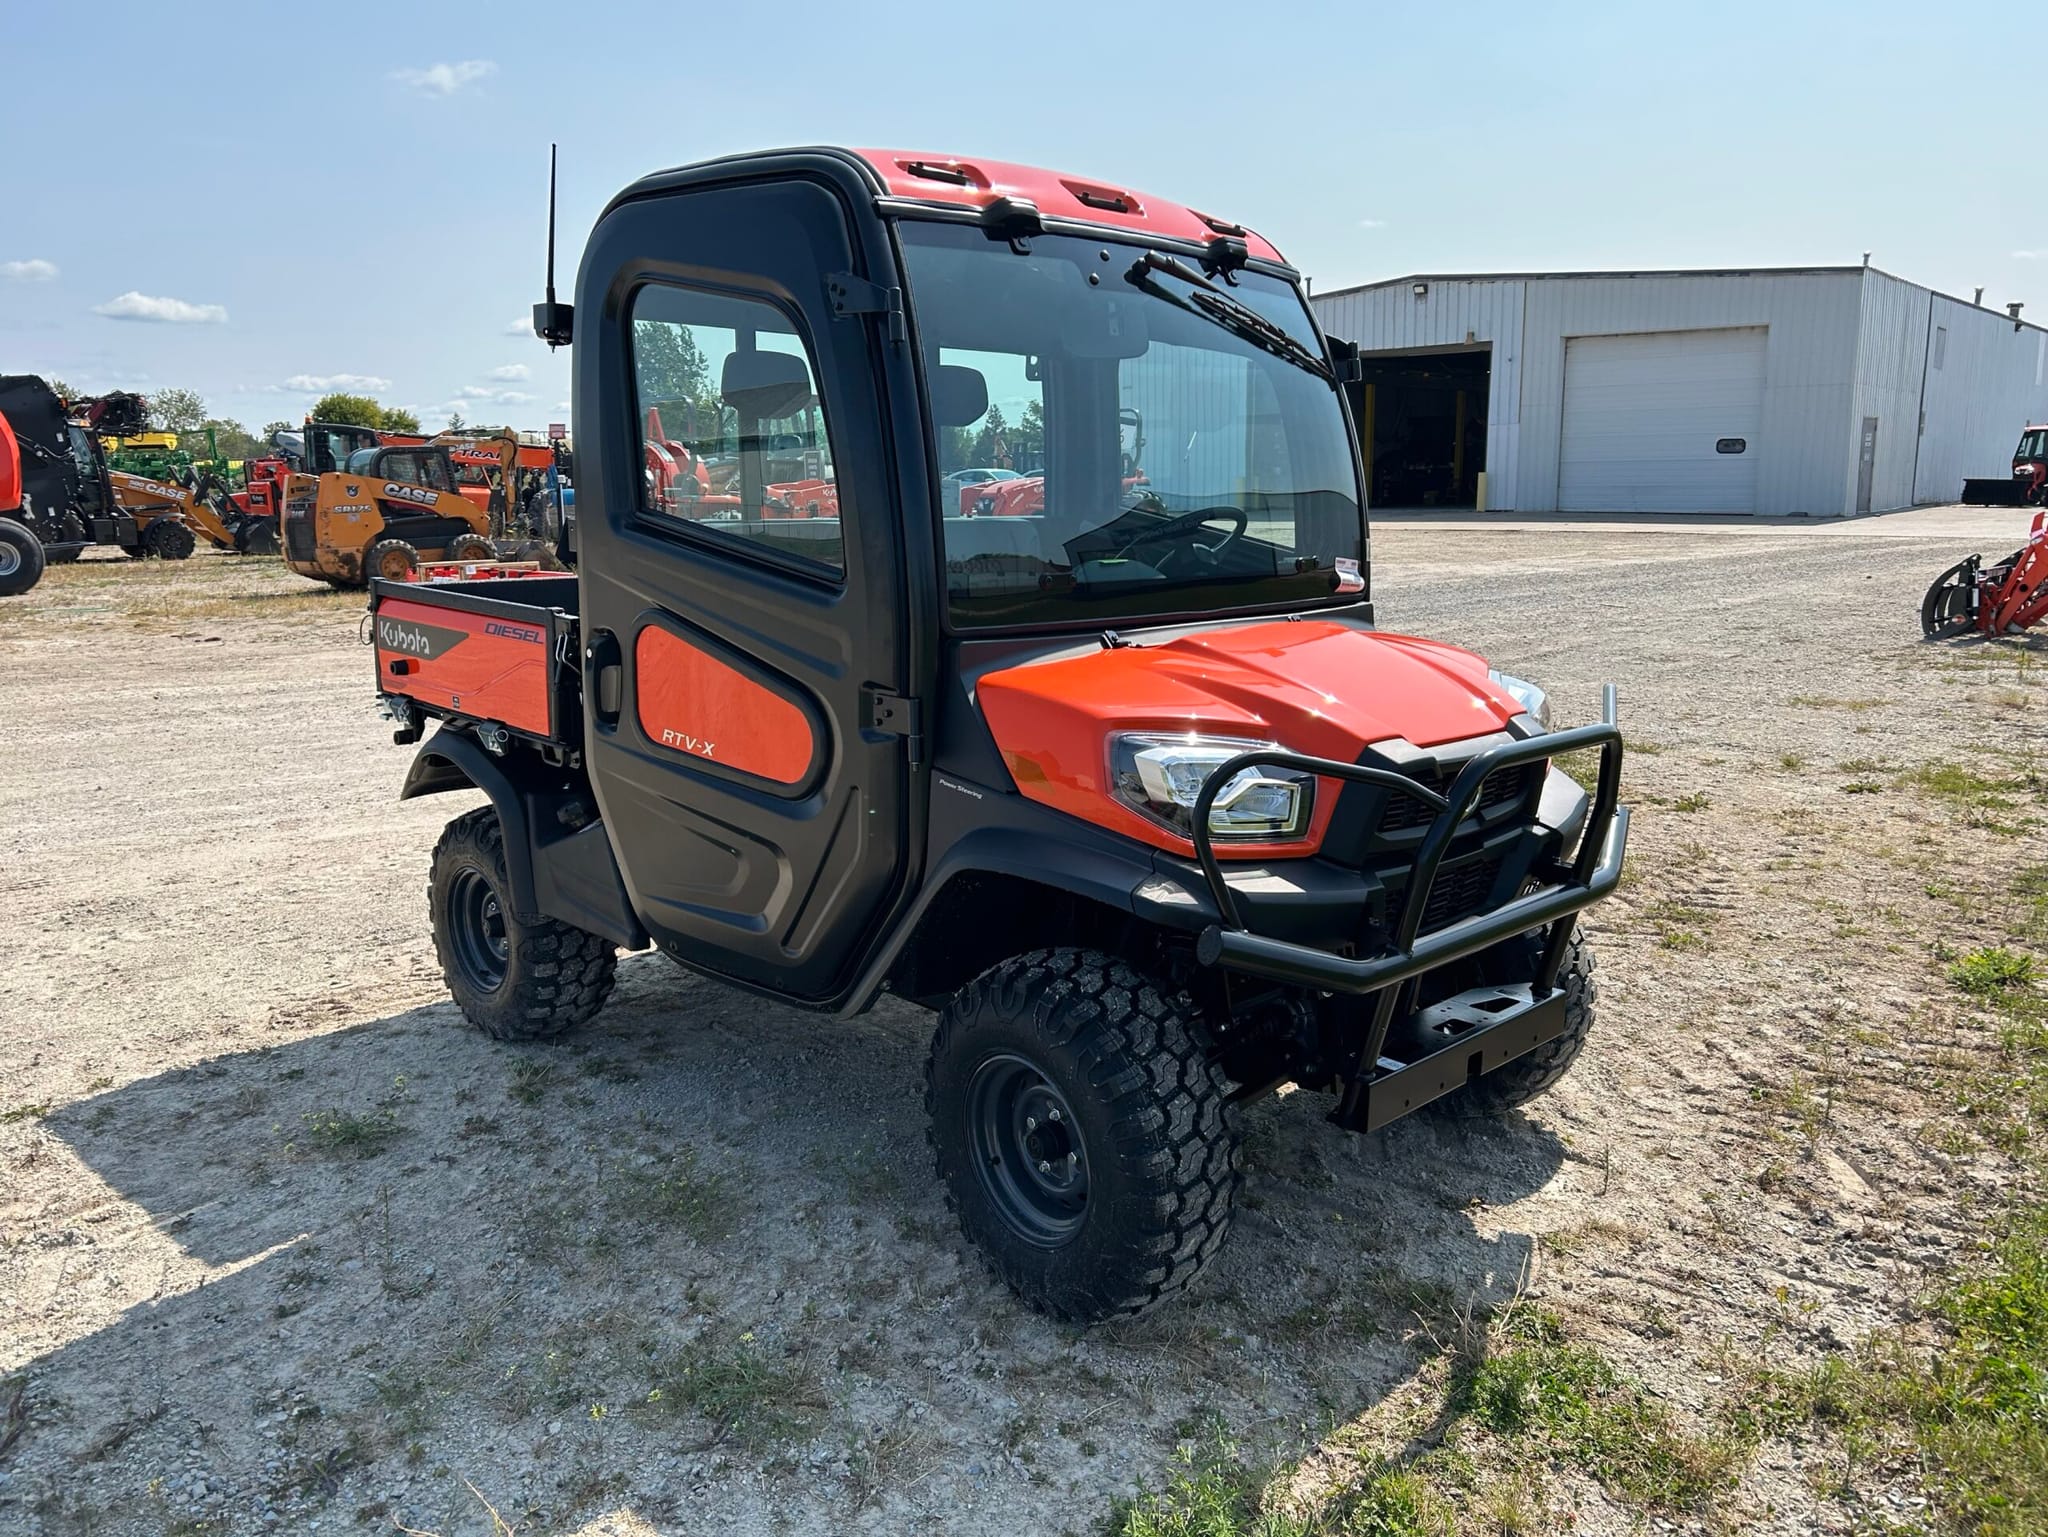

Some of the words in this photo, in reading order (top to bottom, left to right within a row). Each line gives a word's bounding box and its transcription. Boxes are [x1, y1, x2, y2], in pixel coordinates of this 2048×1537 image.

[145, 483, 187, 500] CASE
[384, 482, 439, 505] CASE
[380, 620, 431, 655] Kubota
[484, 622, 544, 645] DIESEL
[662, 728, 716, 757] RTV-X
[939, 778, 957, 789] Power
[957, 785, 983, 800] Steering
